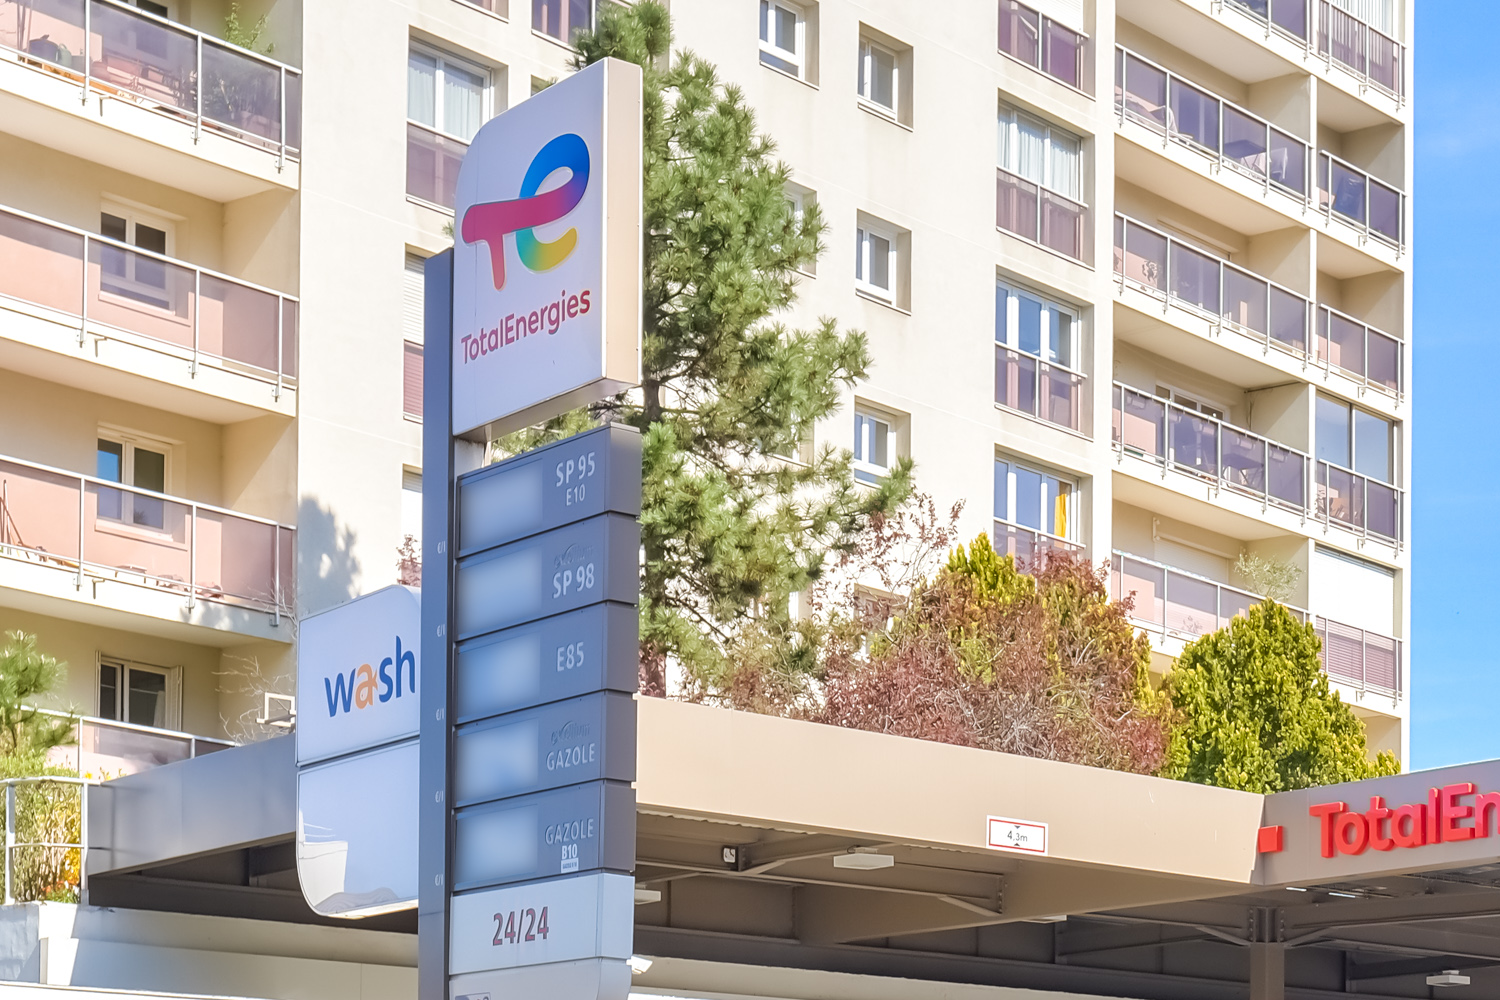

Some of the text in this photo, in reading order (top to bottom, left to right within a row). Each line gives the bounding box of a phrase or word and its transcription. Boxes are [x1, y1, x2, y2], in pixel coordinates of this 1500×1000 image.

[461, 289, 591, 364] TotalEnergies
[556, 452, 596, 487] SP 95
[566, 484, 586, 506] E10
[553, 562, 595, 599] SP 98
[557, 641, 585, 672] E85
[324, 635, 416, 717] wash
[546, 743, 595, 771] GAZOLE
[545, 818, 594, 845] GAZOLE
[561, 843, 578, 860] B10
[492, 906, 549, 946] 24/24
